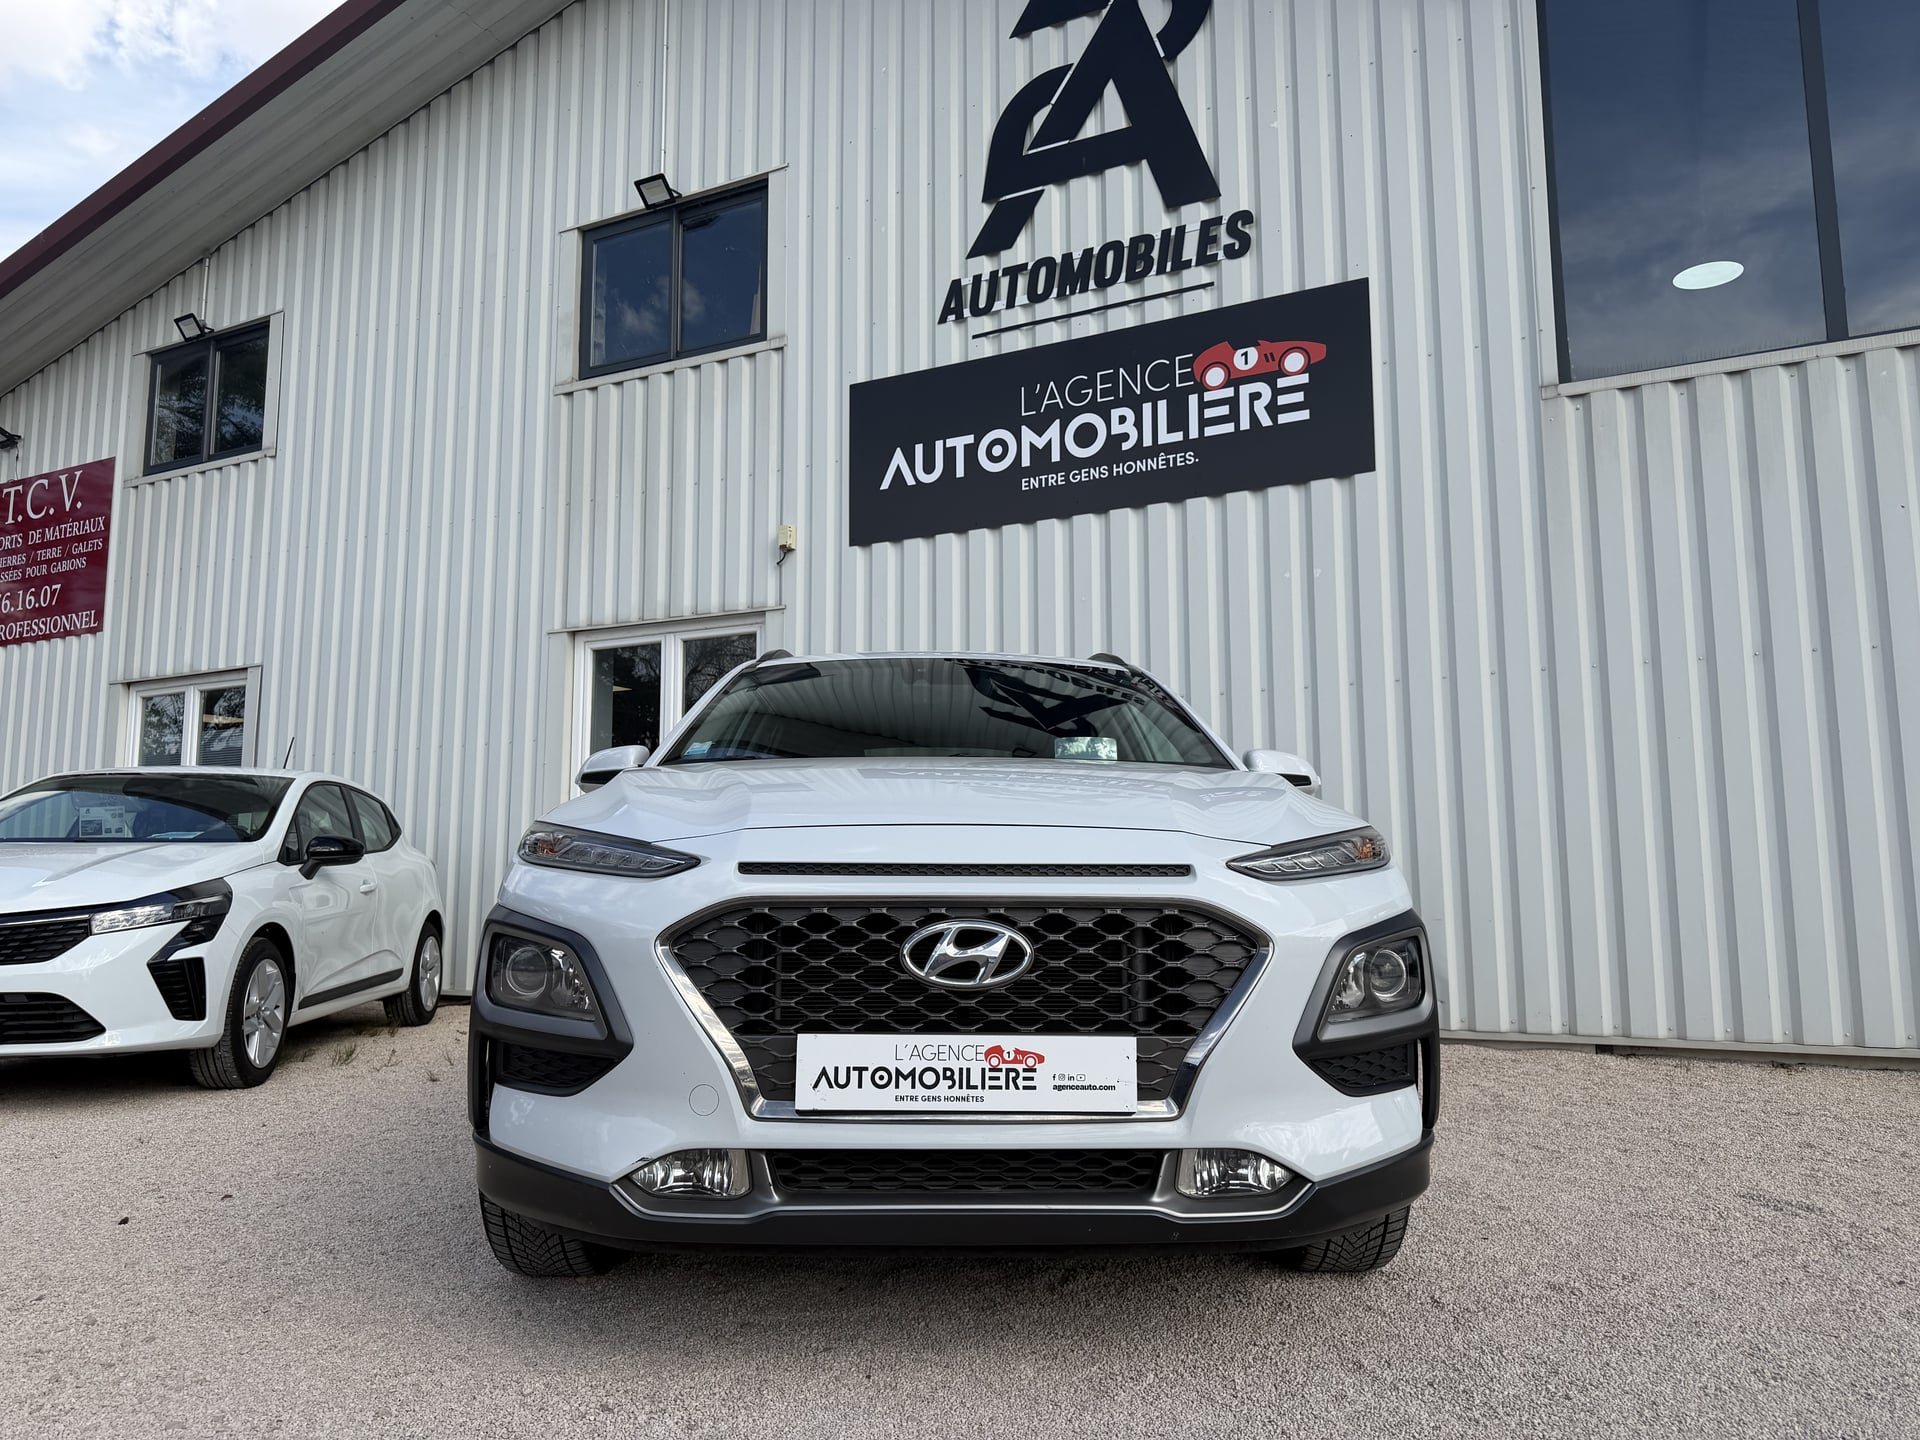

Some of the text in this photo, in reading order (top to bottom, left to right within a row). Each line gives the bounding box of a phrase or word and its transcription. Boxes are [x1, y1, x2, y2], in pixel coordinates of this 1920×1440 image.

[937, 209, 1254, 325] AUTOMOBILES
[1021, 353, 1194, 416] L'AGENCE
[1021, 451, 1200, 491] ENTRE GENS HONNÊTES.
[28, 529, 42, 545] DE
[44, 516, 105, 542] MATÉRIAUX
[37, 546, 62, 561] TERRE
[72, 538, 103, 555] GALETS
[26, 564, 48, 579] POUR
[50, 557, 87, 574] GABIONS
[0, 584, 62, 614] 6.16.07
[895, 1044, 985, 1062] L'AGENCE
[894, 1093, 985, 1103] ENTRE GENS HONNÊTES
[1052, 1084, 1116, 1092] agenceauto.com
